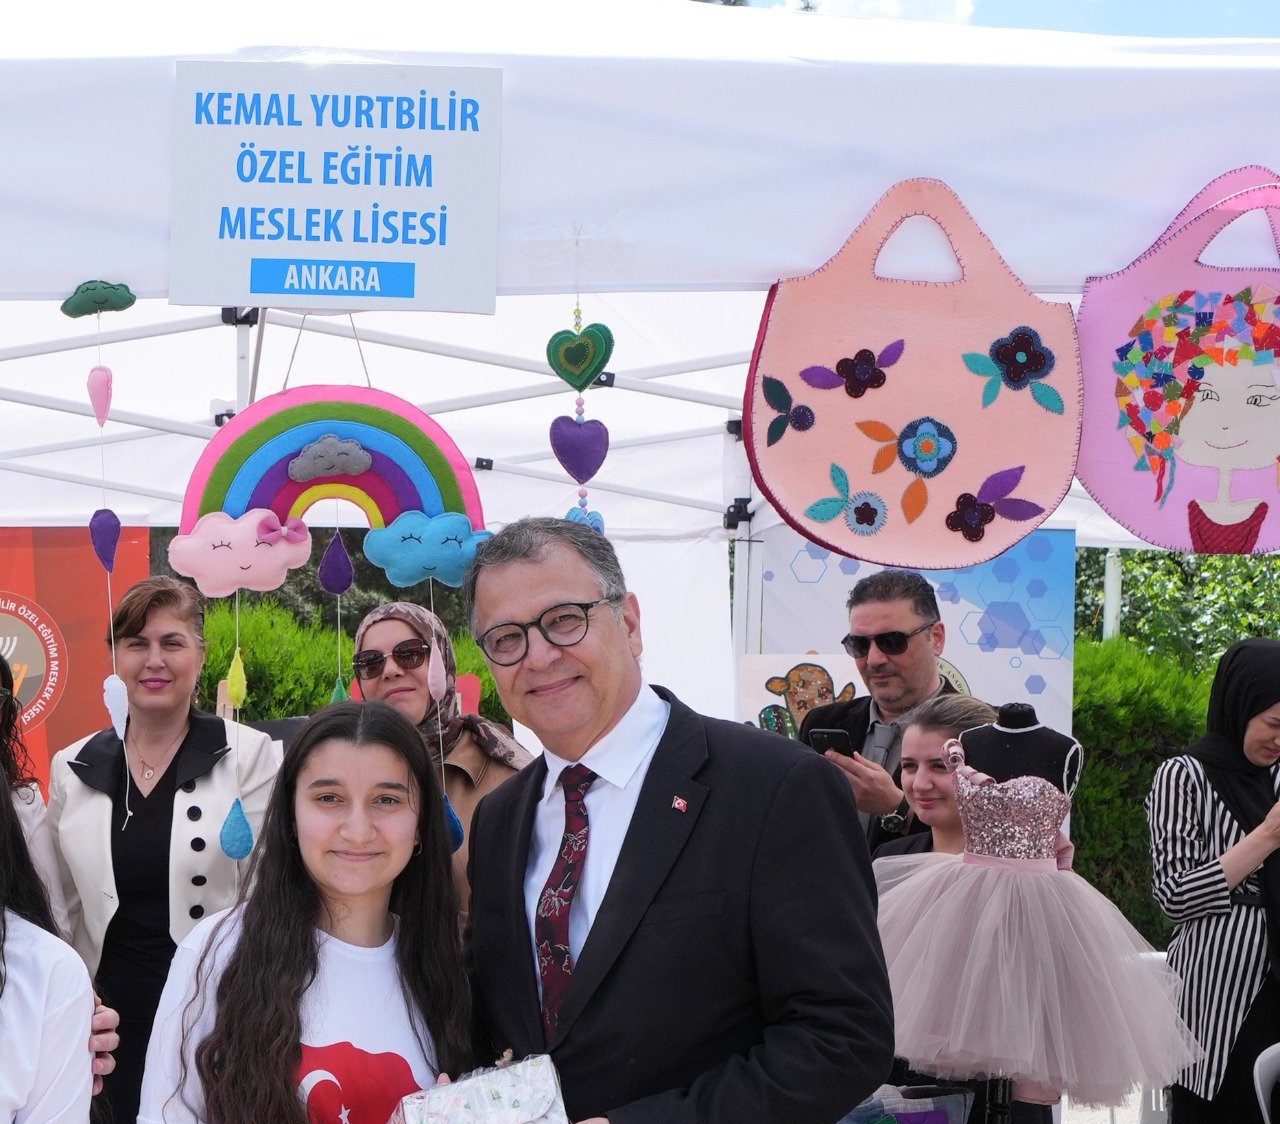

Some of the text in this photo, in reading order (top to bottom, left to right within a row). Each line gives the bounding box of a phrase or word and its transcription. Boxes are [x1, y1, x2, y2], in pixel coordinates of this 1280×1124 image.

[194, 89, 480, 132] KEMAL YURTBİLİR
[236, 142, 433, 188] ÖZEL EĞİTİM
[218, 202, 448, 246] MESLEK LİSESİ
[283, 264, 381, 292] ANKARA
[17, 604, 40, 626] ÖZEL
[37, 623, 59, 659] EĞİTİM
[41, 660, 59, 701] MESLEK
[21, 699, 47, 725] LİSESİ
